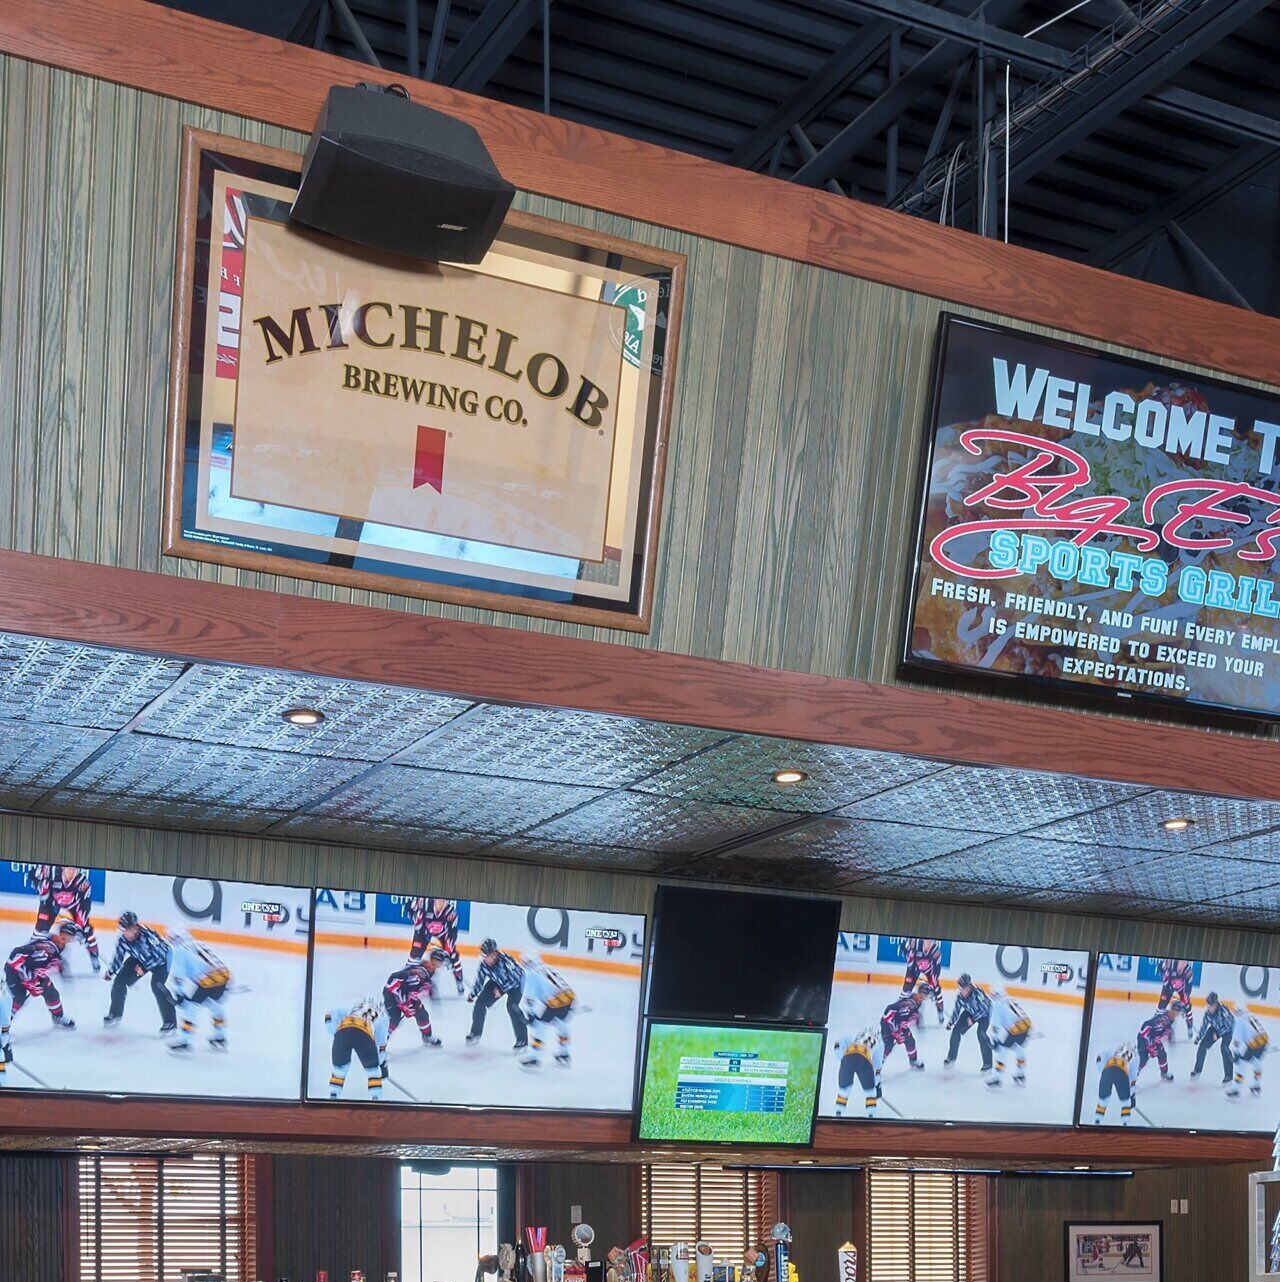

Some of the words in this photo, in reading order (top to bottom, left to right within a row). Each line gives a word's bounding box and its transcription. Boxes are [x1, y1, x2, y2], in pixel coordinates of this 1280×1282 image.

[252, 301, 610, 430] MICHELOB
[342, 363, 479, 416] BREWING
[485, 395, 528, 428] CO.
[993, 357, 1235, 466] WELCOME
[952, 429, 1159, 552] Big
[989, 530, 1169, 597] SPORTS
[931, 578, 996, 607] FRESH,
[1005, 592, 1094, 625] FRIENDLY,
[1099, 609, 1134, 629] AND
[1141, 616, 1178, 637] FUN!
[1185, 623, 1235, 646] EVERY
[989, 617, 1007, 635] IS
[1015, 622, 1120, 654] EMPOWERED
[1128, 640, 1150, 659] TO
[1156, 645, 1217, 669] EXCEED
[1224, 657, 1265, 678] YOUR
[1062, 657, 1191, 692] EXPECTATIONS.
[241, 902, 261, 912] ONE
